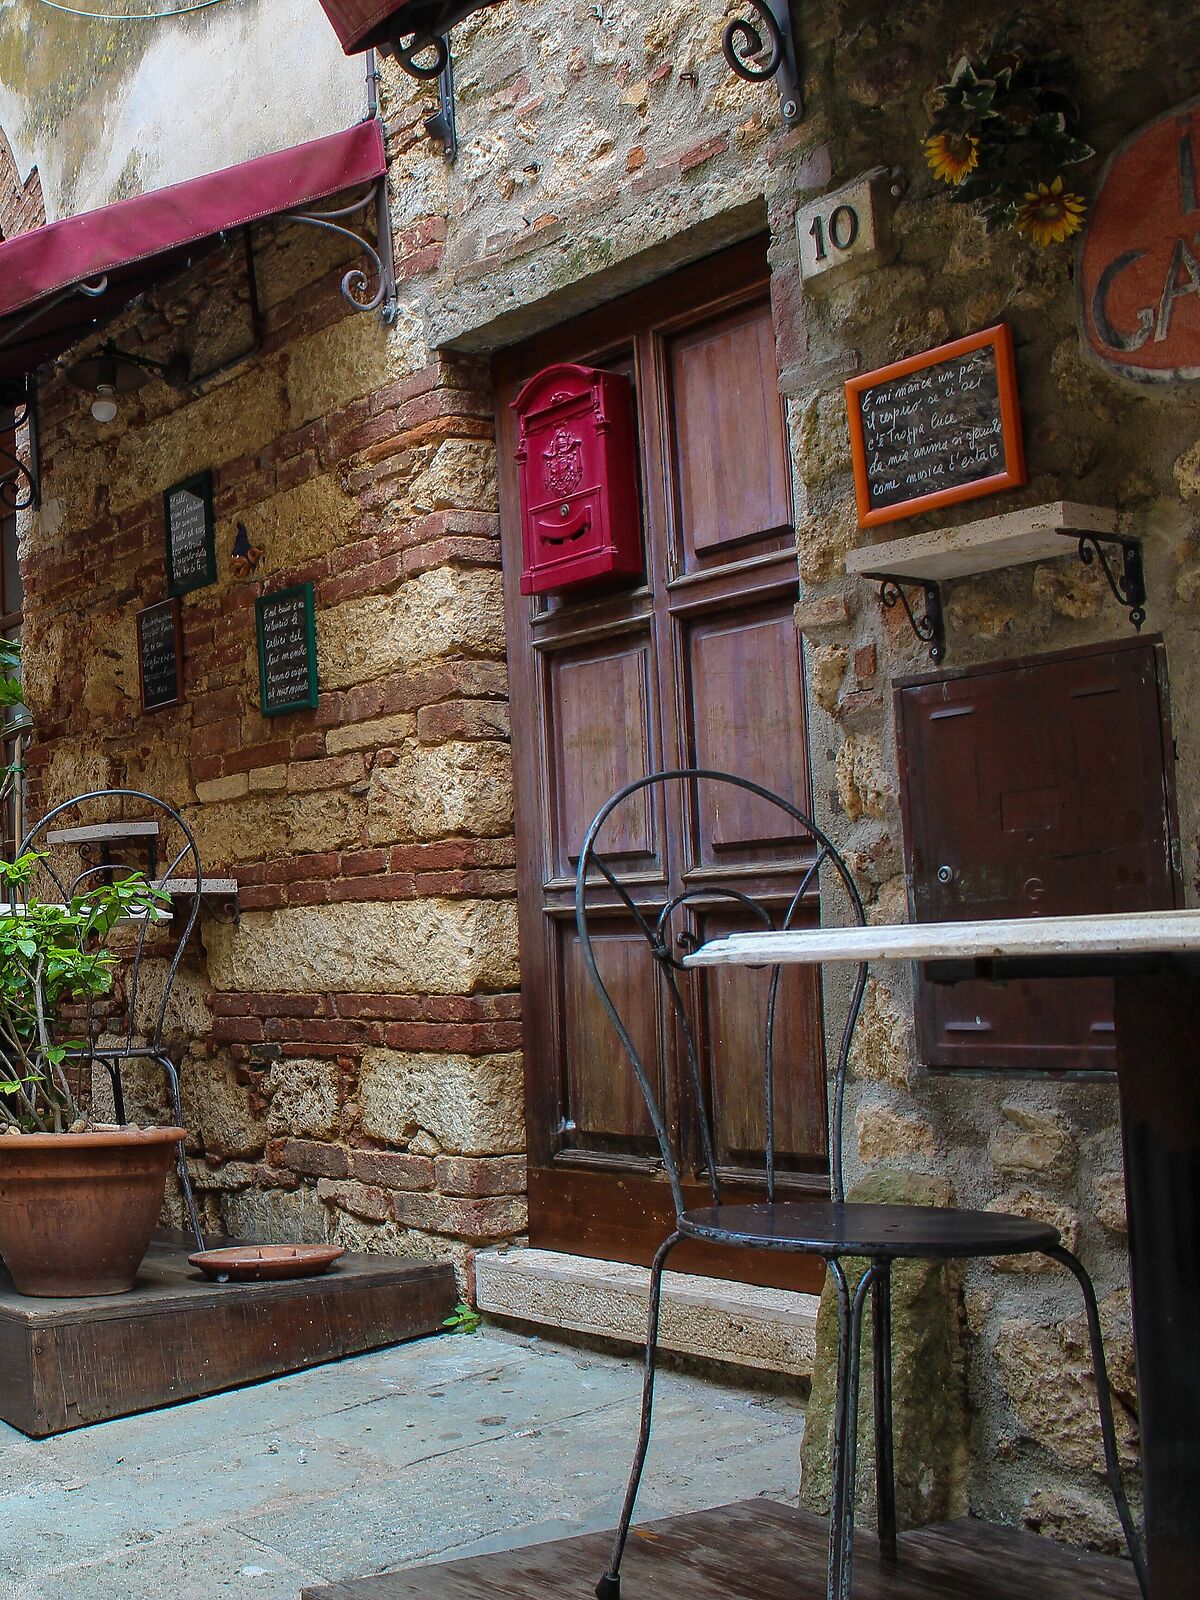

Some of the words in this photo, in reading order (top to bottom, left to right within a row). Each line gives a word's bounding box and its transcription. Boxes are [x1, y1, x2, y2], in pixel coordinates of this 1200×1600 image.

[809, 205, 858, 261] 10
[862, 390, 873, 411] E
[875, 388, 892, 405] mi
[895, 377, 932, 398] manca
[938, 370, 955, 383] un
[866, 411, 876, 430] il
[888, 449, 909, 466] mia
[913, 438, 948, 459] anima
[873, 480, 900, 495] come
[906, 464, 945, 484] musica
